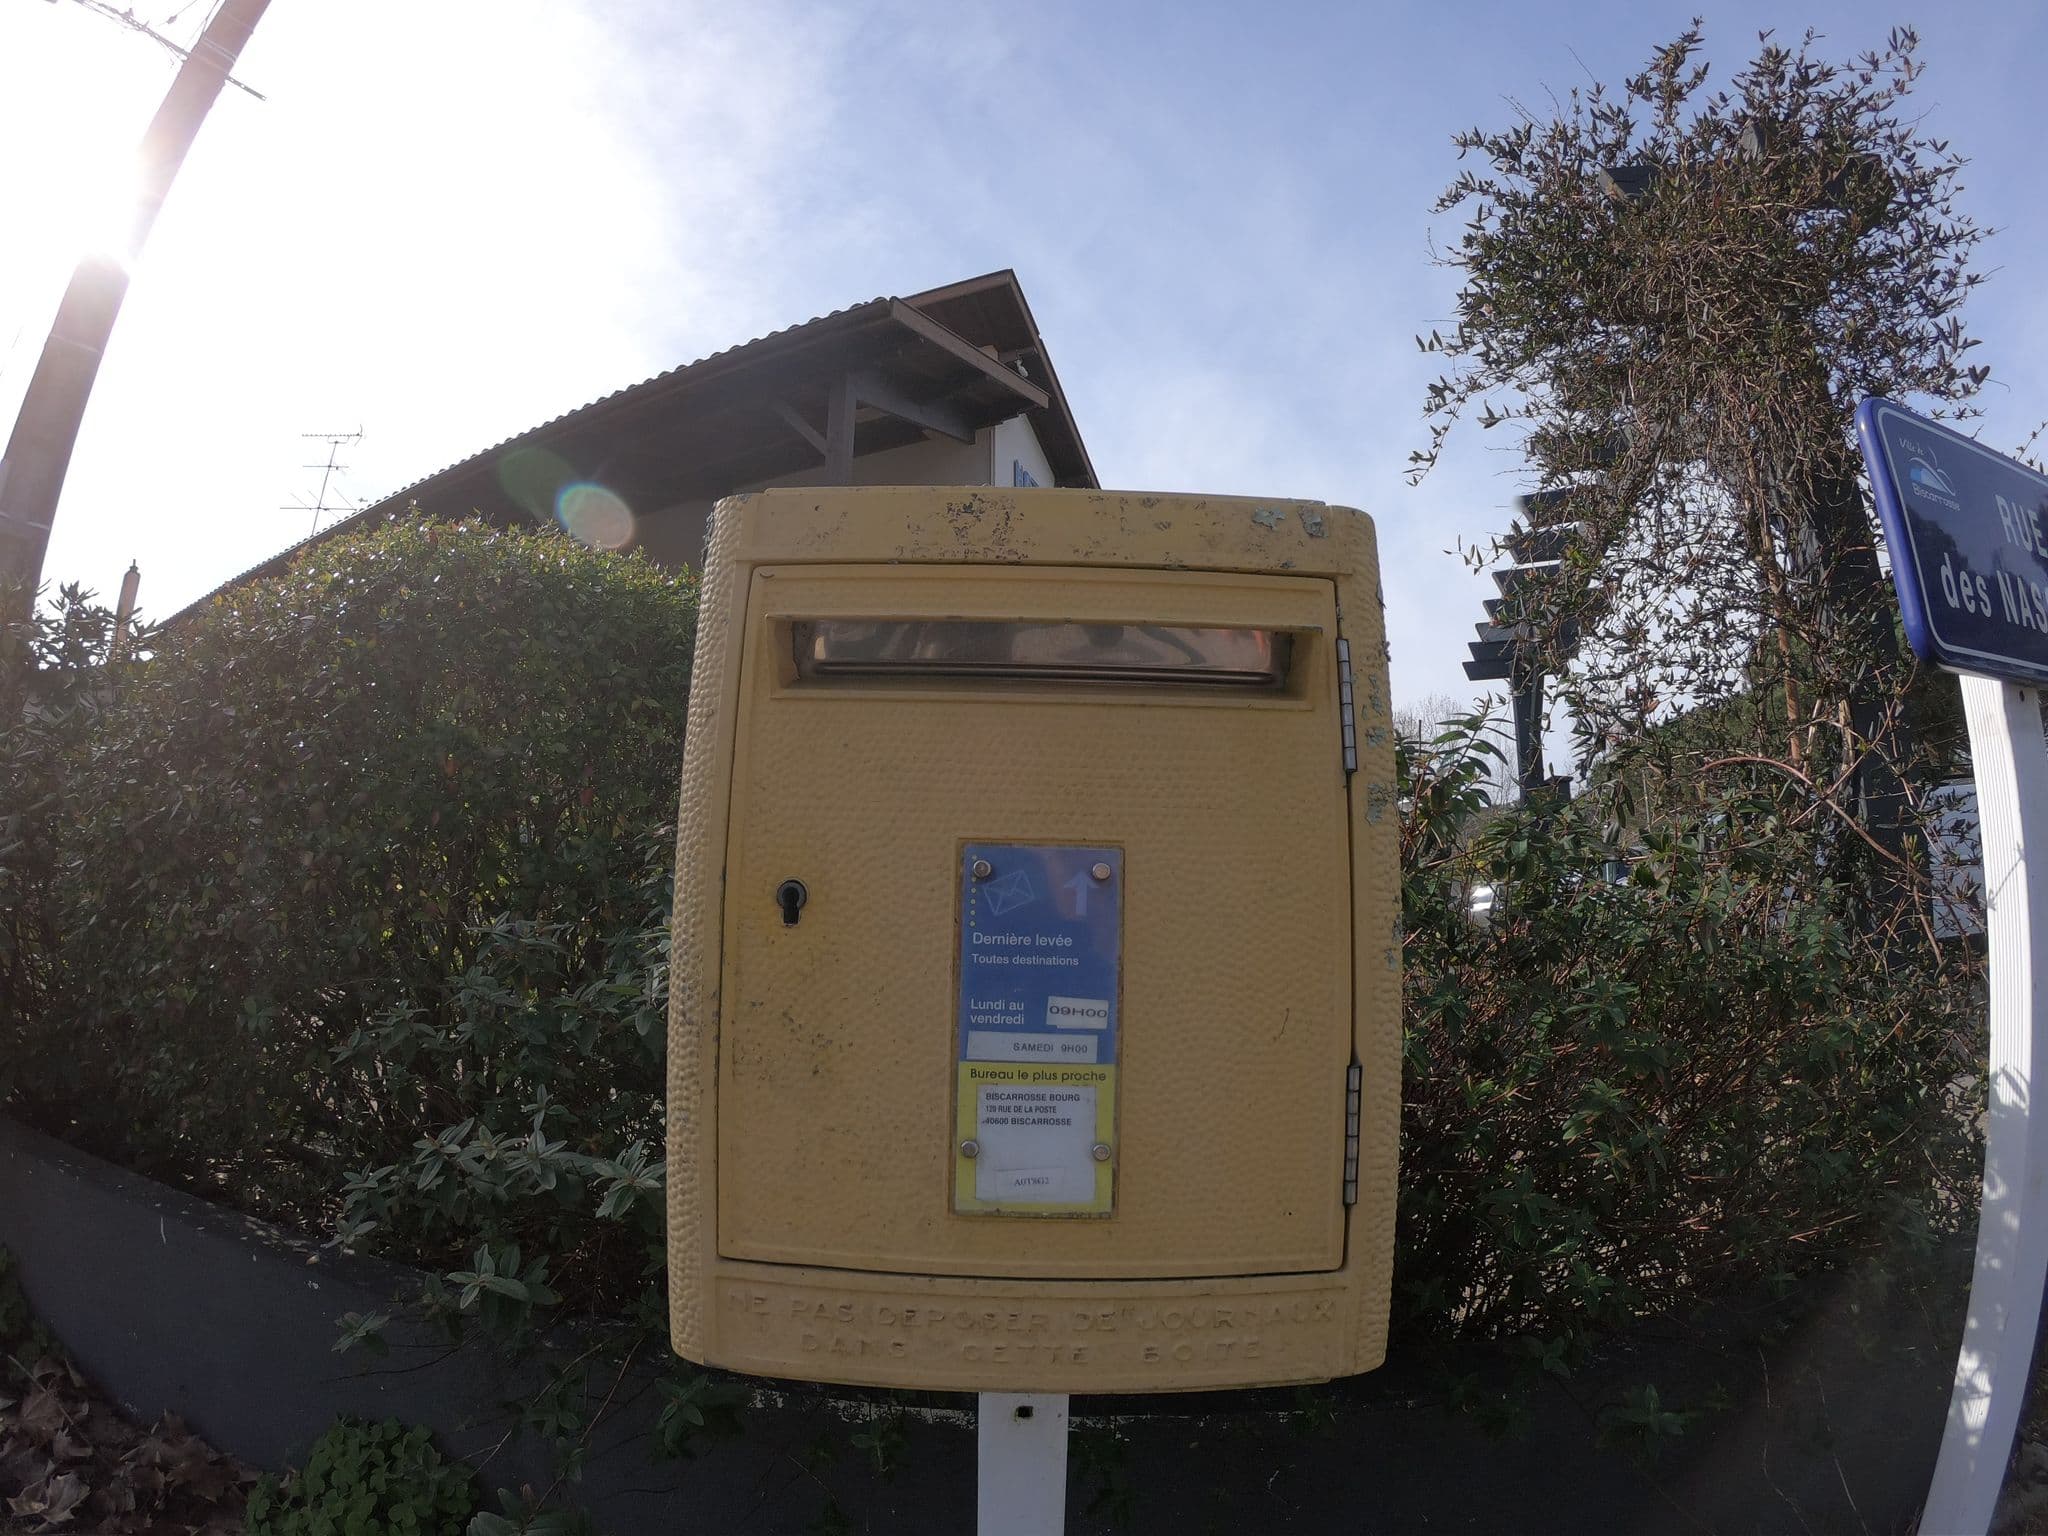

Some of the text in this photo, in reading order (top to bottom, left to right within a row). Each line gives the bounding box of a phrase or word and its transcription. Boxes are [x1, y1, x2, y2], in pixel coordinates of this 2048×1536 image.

[1995, 493, 2048, 559] RUE
[1940, 552, 2048, 634] des NAS
[972, 932, 1073, 947] Dernière levée
[971, 953, 1079, 967] Toutes destinations
[970, 998, 1025, 1011] Lundi au
[970, 1013, 1025, 1025] vendredi
[1049, 1005, 1108, 1019] 09H00
[1013, 1042, 1088, 1054] SAMEDI 9H00
[970, 1068, 1107, 1083] Bureau le plus proche
[985, 1092, 1081, 1102] BISCARROSSE BOURG
[998, 1105, 1011, 1113] RUE
[1013, 1105, 1023, 1113] DE
[1024, 1105, 1033, 1113] LA
[1034, 1105, 1057, 1114] POSTE
[1010, 1117, 1072, 1126] BISCARROSSE
[791, 1301, 855, 1323] PAS
[877, 1306, 1048, 1332] DEPOSER
[961, 1343, 1089, 1365] CETTE
[1142, 1340, 1259, 1364] BOITE
